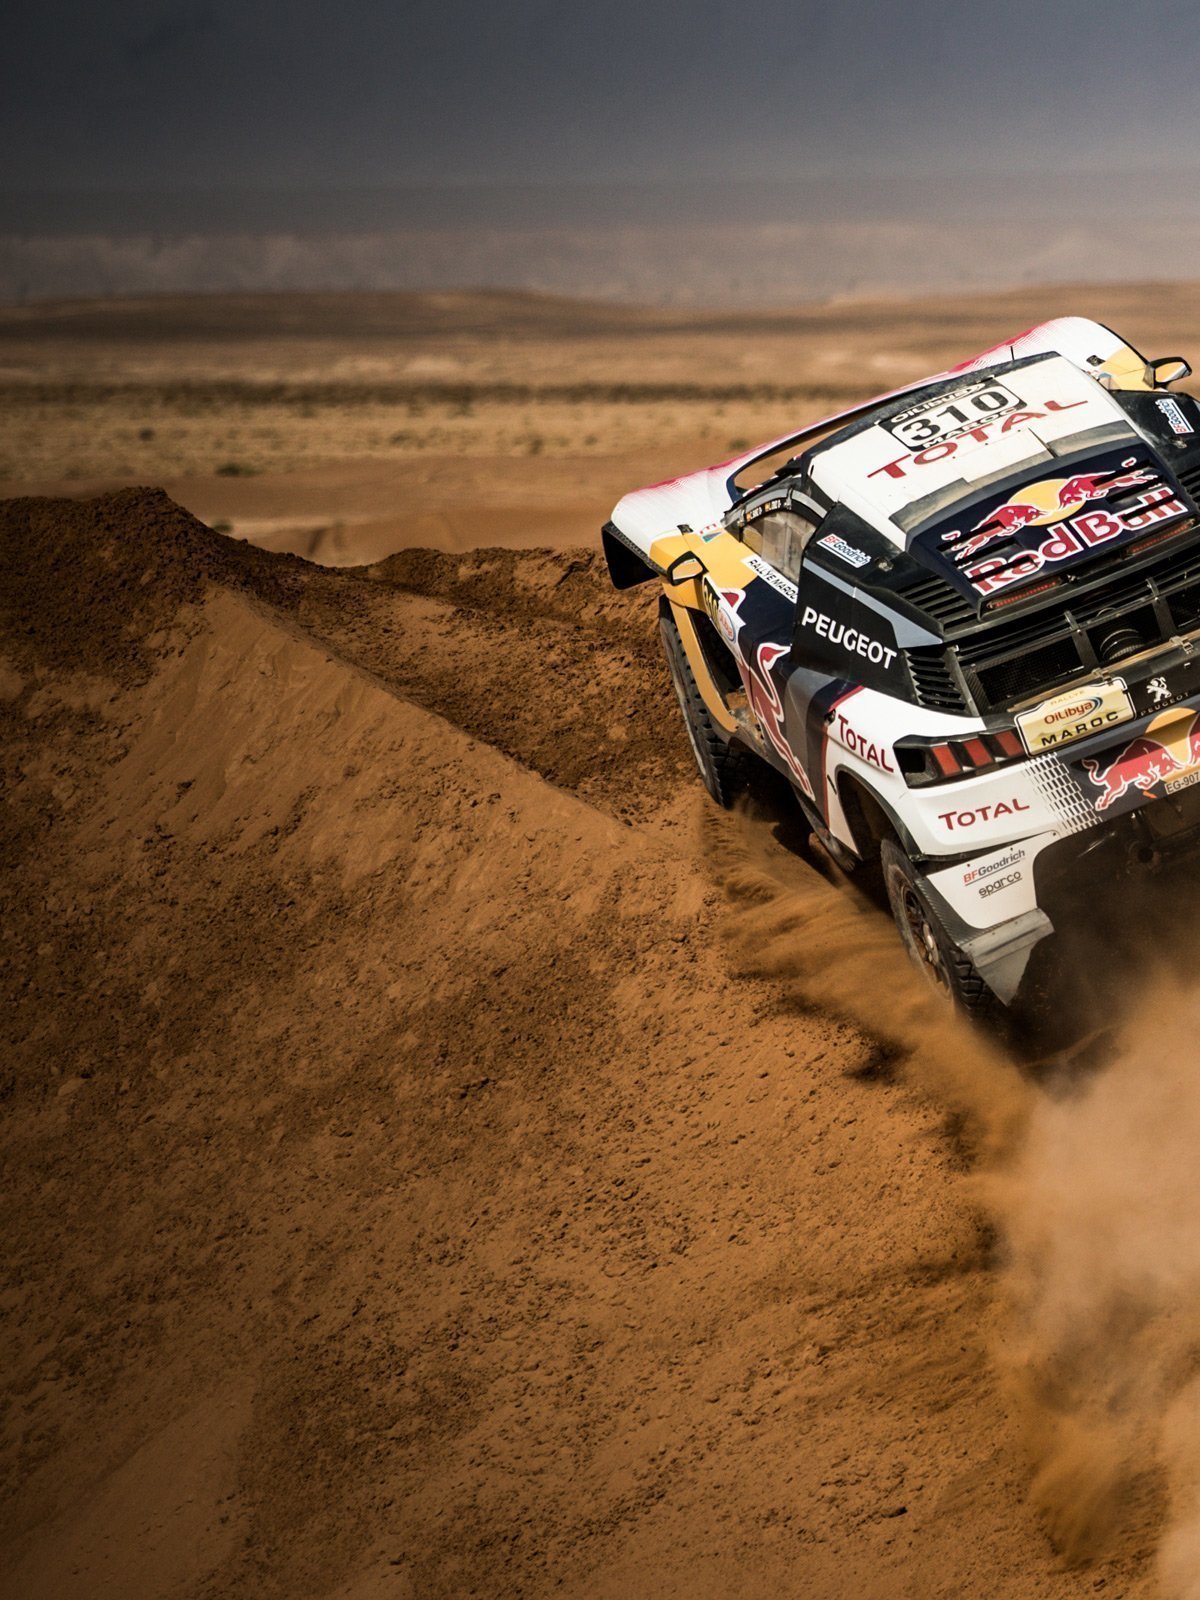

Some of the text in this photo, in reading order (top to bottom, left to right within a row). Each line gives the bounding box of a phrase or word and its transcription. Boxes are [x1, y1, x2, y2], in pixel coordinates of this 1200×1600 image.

[902, 391, 1009, 441] 310
[922, 407, 1018, 448] MAROC
[867, 400, 1088, 479] TOTAL
[823, 535, 873, 567] BFGoodrich
[964, 486, 1188, 595] Red Bull
[801, 606, 897, 669] PEUGEOT
[1044, 701, 1093, 725] OiLibya
[1140, 691, 1191, 716] PEUGEOT
[838, 714, 894, 773] TOTAL
[1041, 711, 1119, 746] MAROC
[938, 798, 1030, 831] TOTAL
[963, 849, 1026, 884] BFGoodrich
[978, 871, 1022, 897] sparco
